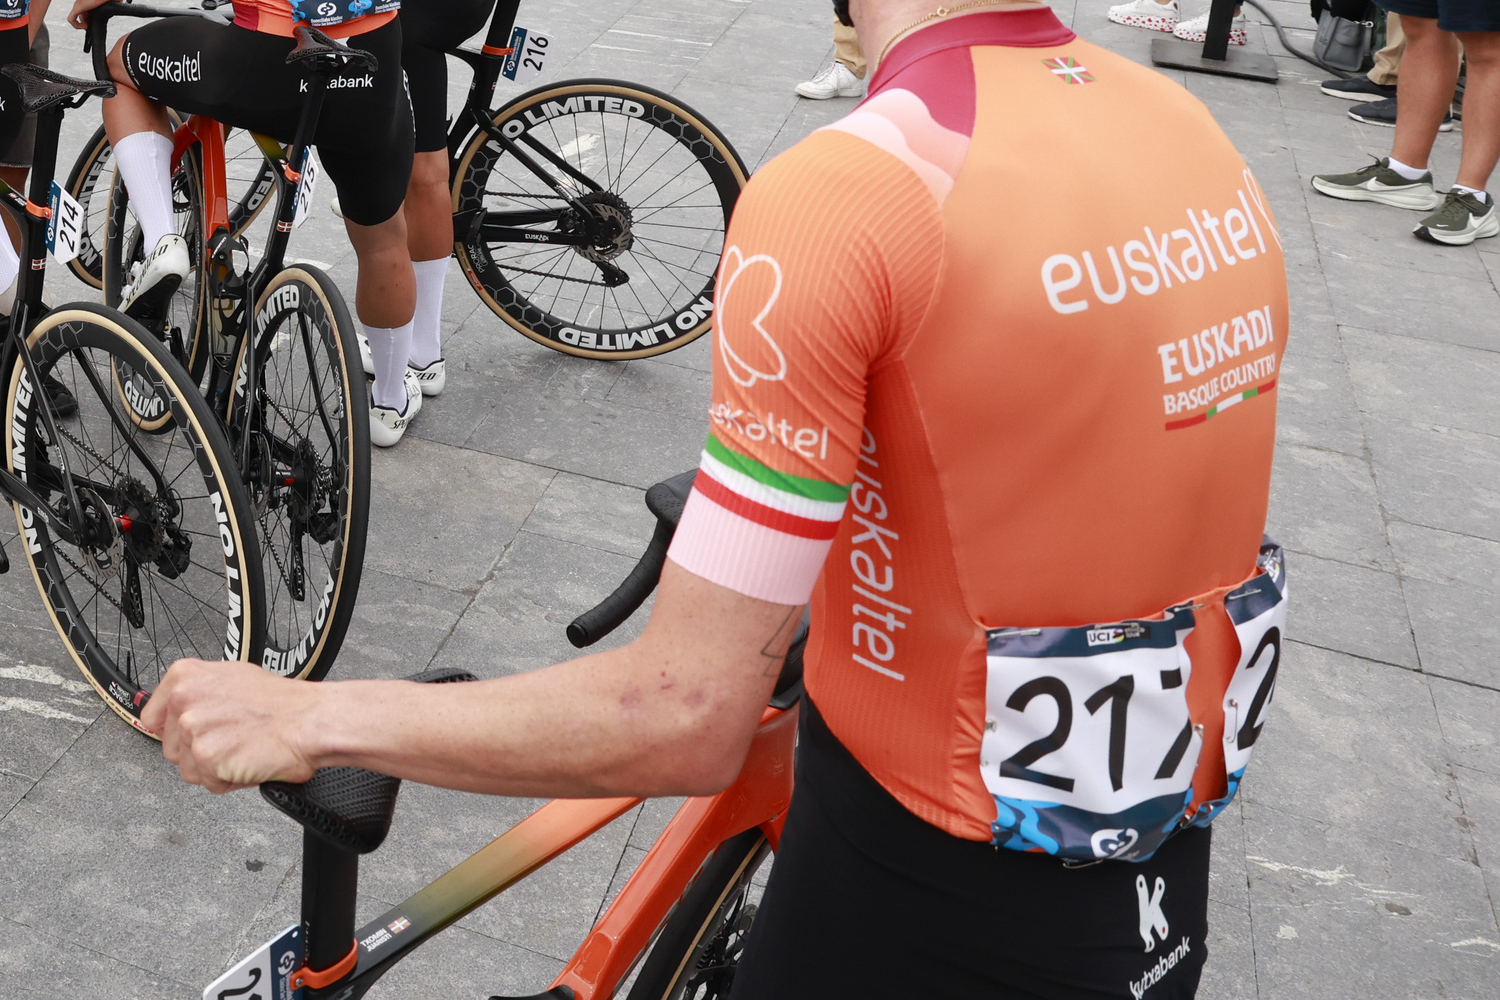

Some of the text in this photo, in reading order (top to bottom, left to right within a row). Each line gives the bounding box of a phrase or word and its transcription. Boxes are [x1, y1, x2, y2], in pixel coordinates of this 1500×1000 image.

[138, 50, 201, 83] euskaltel
[523, 36, 549, 72] 216
[528, 95, 646, 124] LIMITED
[300, 163, 316, 214] 215
[59, 200, 79, 253] 214
[80, 236, 98, 268] NO
[1040, 188, 1266, 315] euskaltel
[467, 244, 485, 274] PRORAC
[558, 296, 714, 352] NO LIMITED
[1157, 305, 1275, 384] EUSKADI
[1162, 354, 1277, 415] BASQUE COUNTRY
[209, 491, 242, 662] NO LIMIT
[849, 424, 912, 682] euskaltel
[261, 572, 335, 678] NO LIMITED
[1089, 630, 1112, 645] UCI
[999, 667, 1195, 794] 217
[360, 927, 388, 948] TXOMIN
[366, 932, 392, 953] JUARISTI
[1129, 935, 1191, 1000] kutxabank
